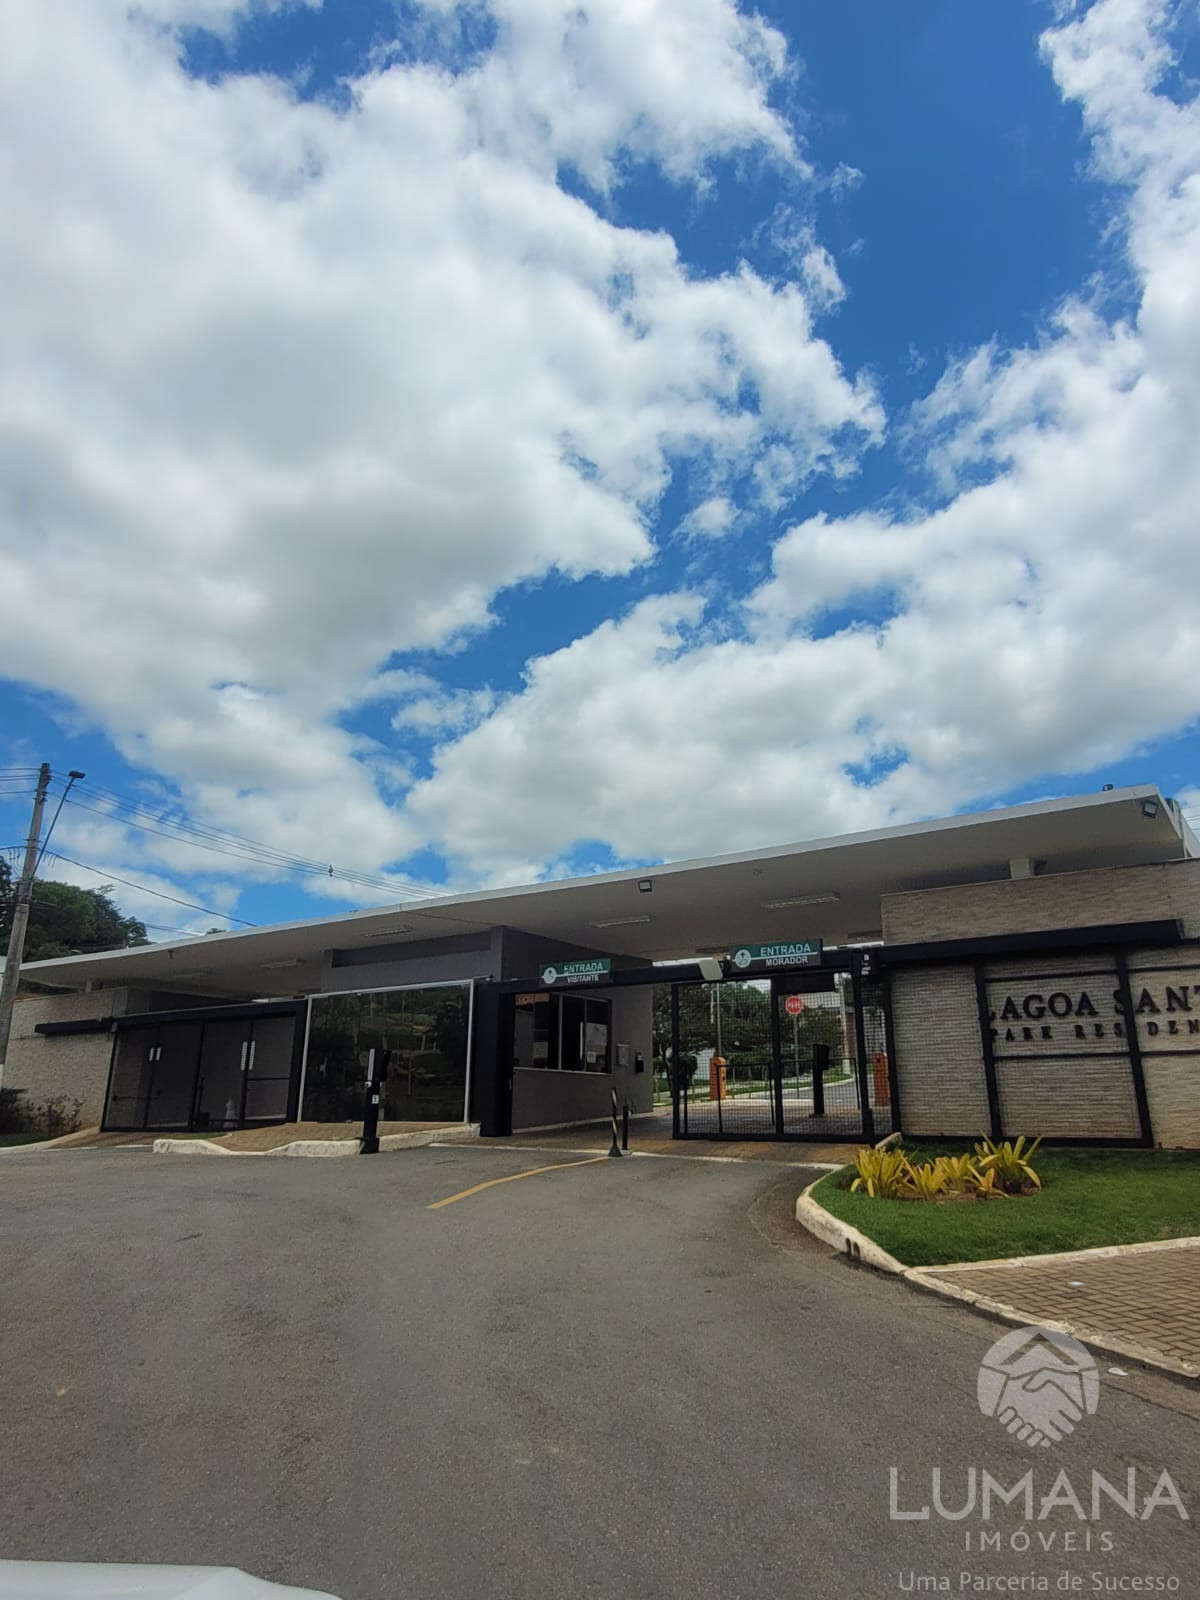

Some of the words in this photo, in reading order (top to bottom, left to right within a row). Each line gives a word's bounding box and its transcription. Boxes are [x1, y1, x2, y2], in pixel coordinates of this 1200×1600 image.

[760, 943, 811, 957] ENTRADA
[563, 961, 604, 973] ENTRADA
[765, 955, 809, 967] MORADOR
